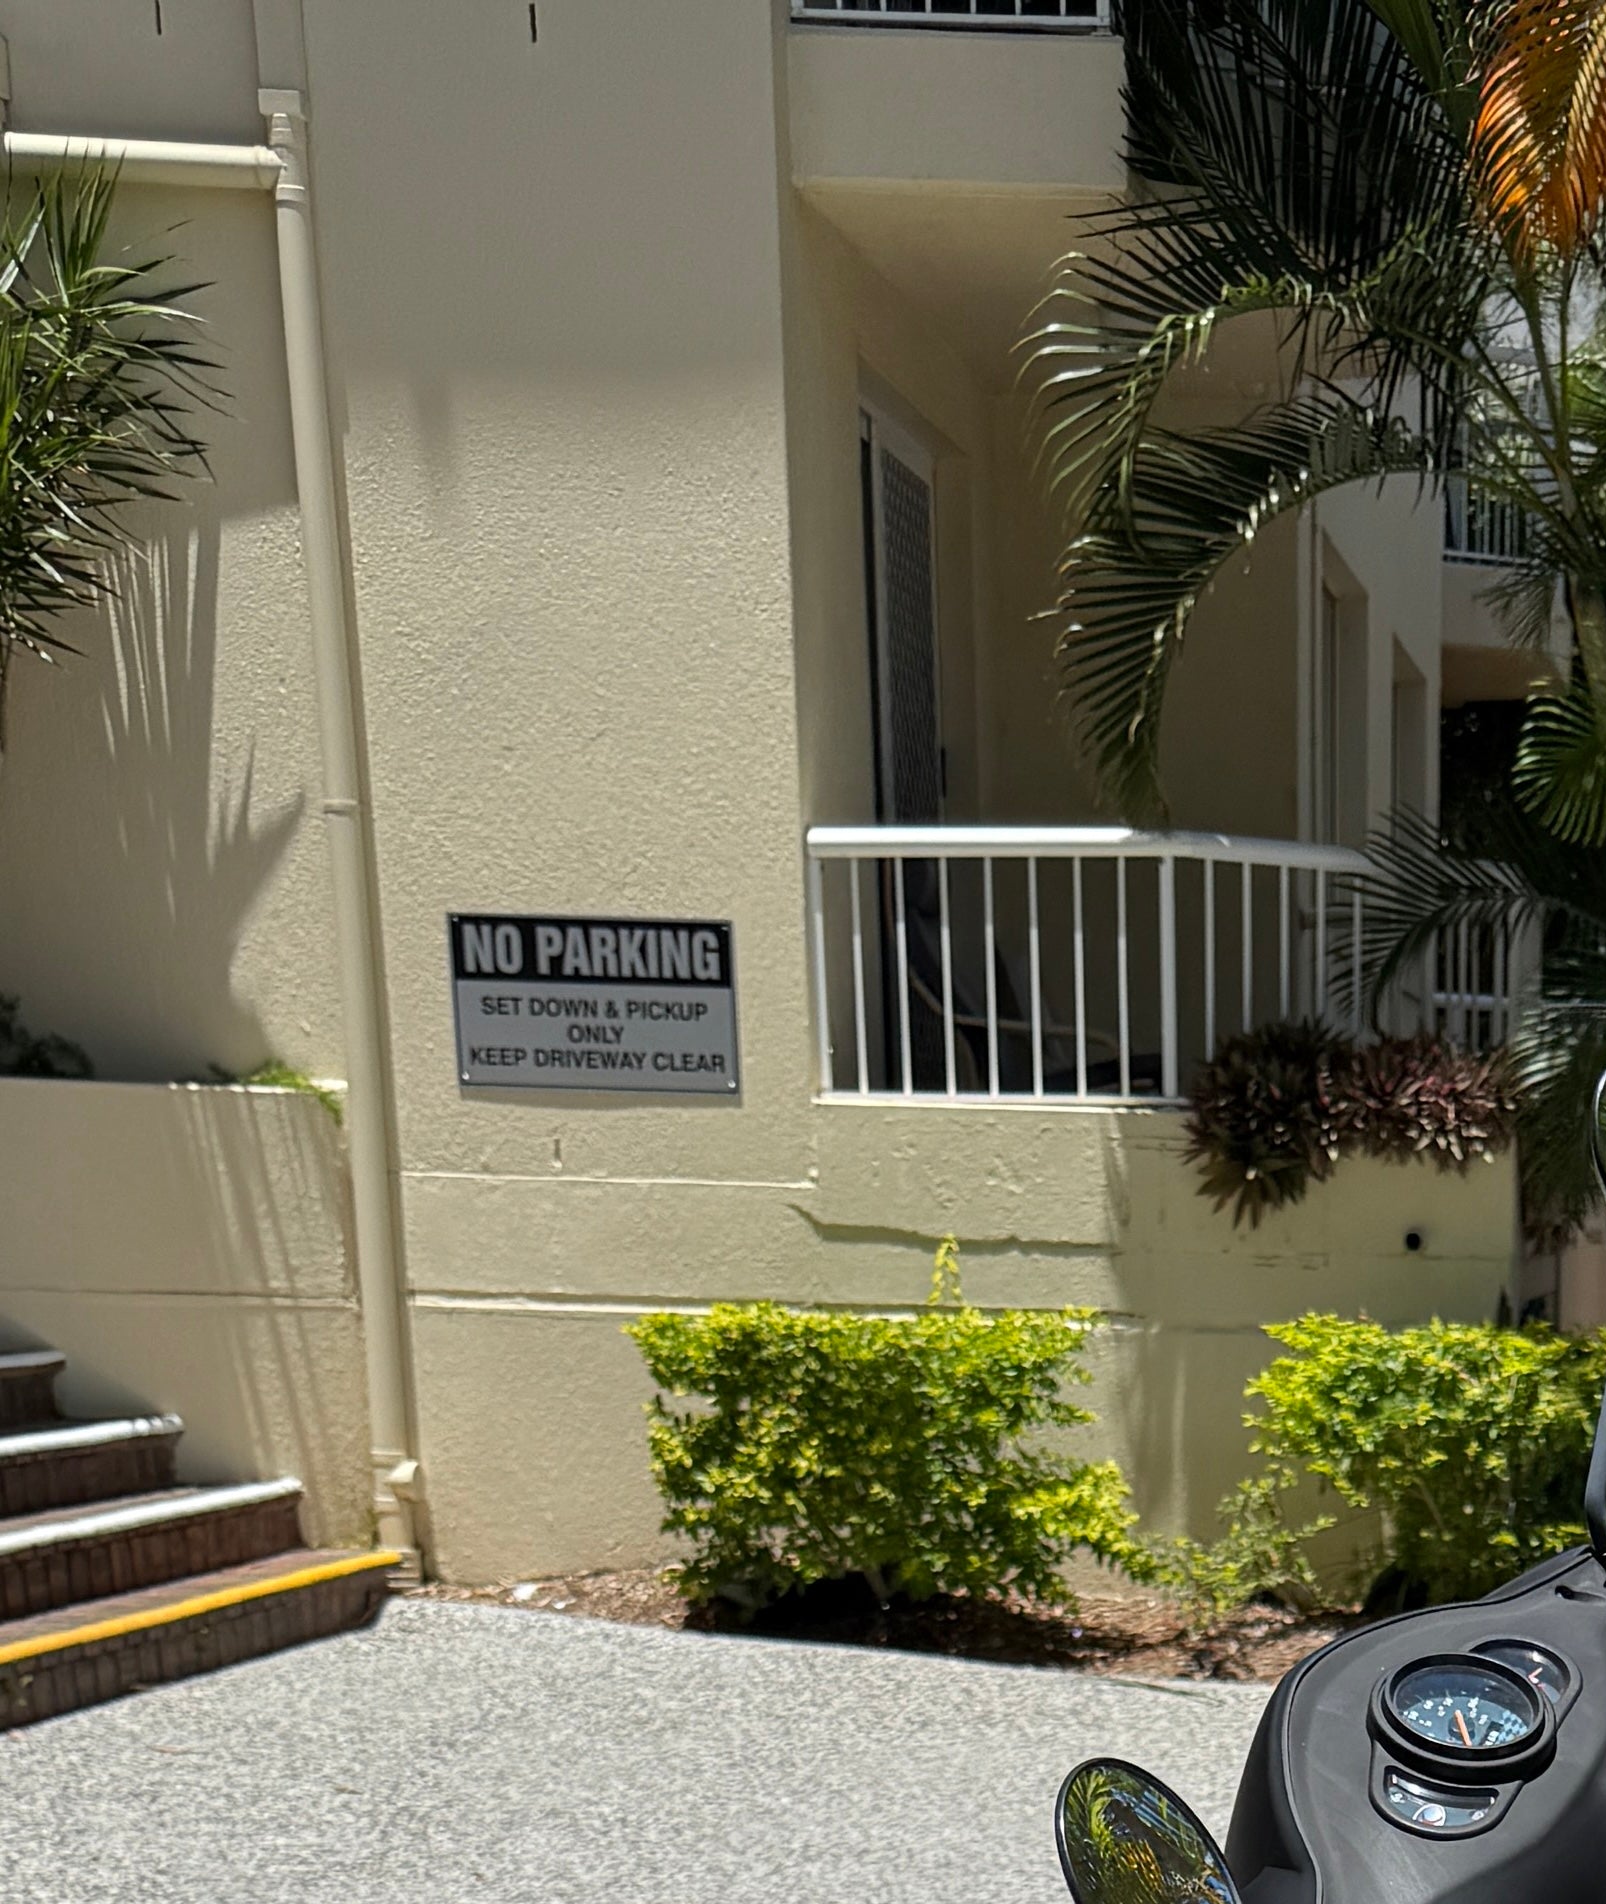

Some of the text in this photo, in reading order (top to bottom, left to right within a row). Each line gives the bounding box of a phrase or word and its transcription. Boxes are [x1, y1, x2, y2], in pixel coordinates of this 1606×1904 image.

[461, 922, 722, 981] NO PARKING
[481, 996, 708, 1022] SET DOWN & PICKUP
[566, 1024, 624, 1044] ONLY
[470, 1047, 726, 1074] KEEP DRIVEWAY CLEAR
